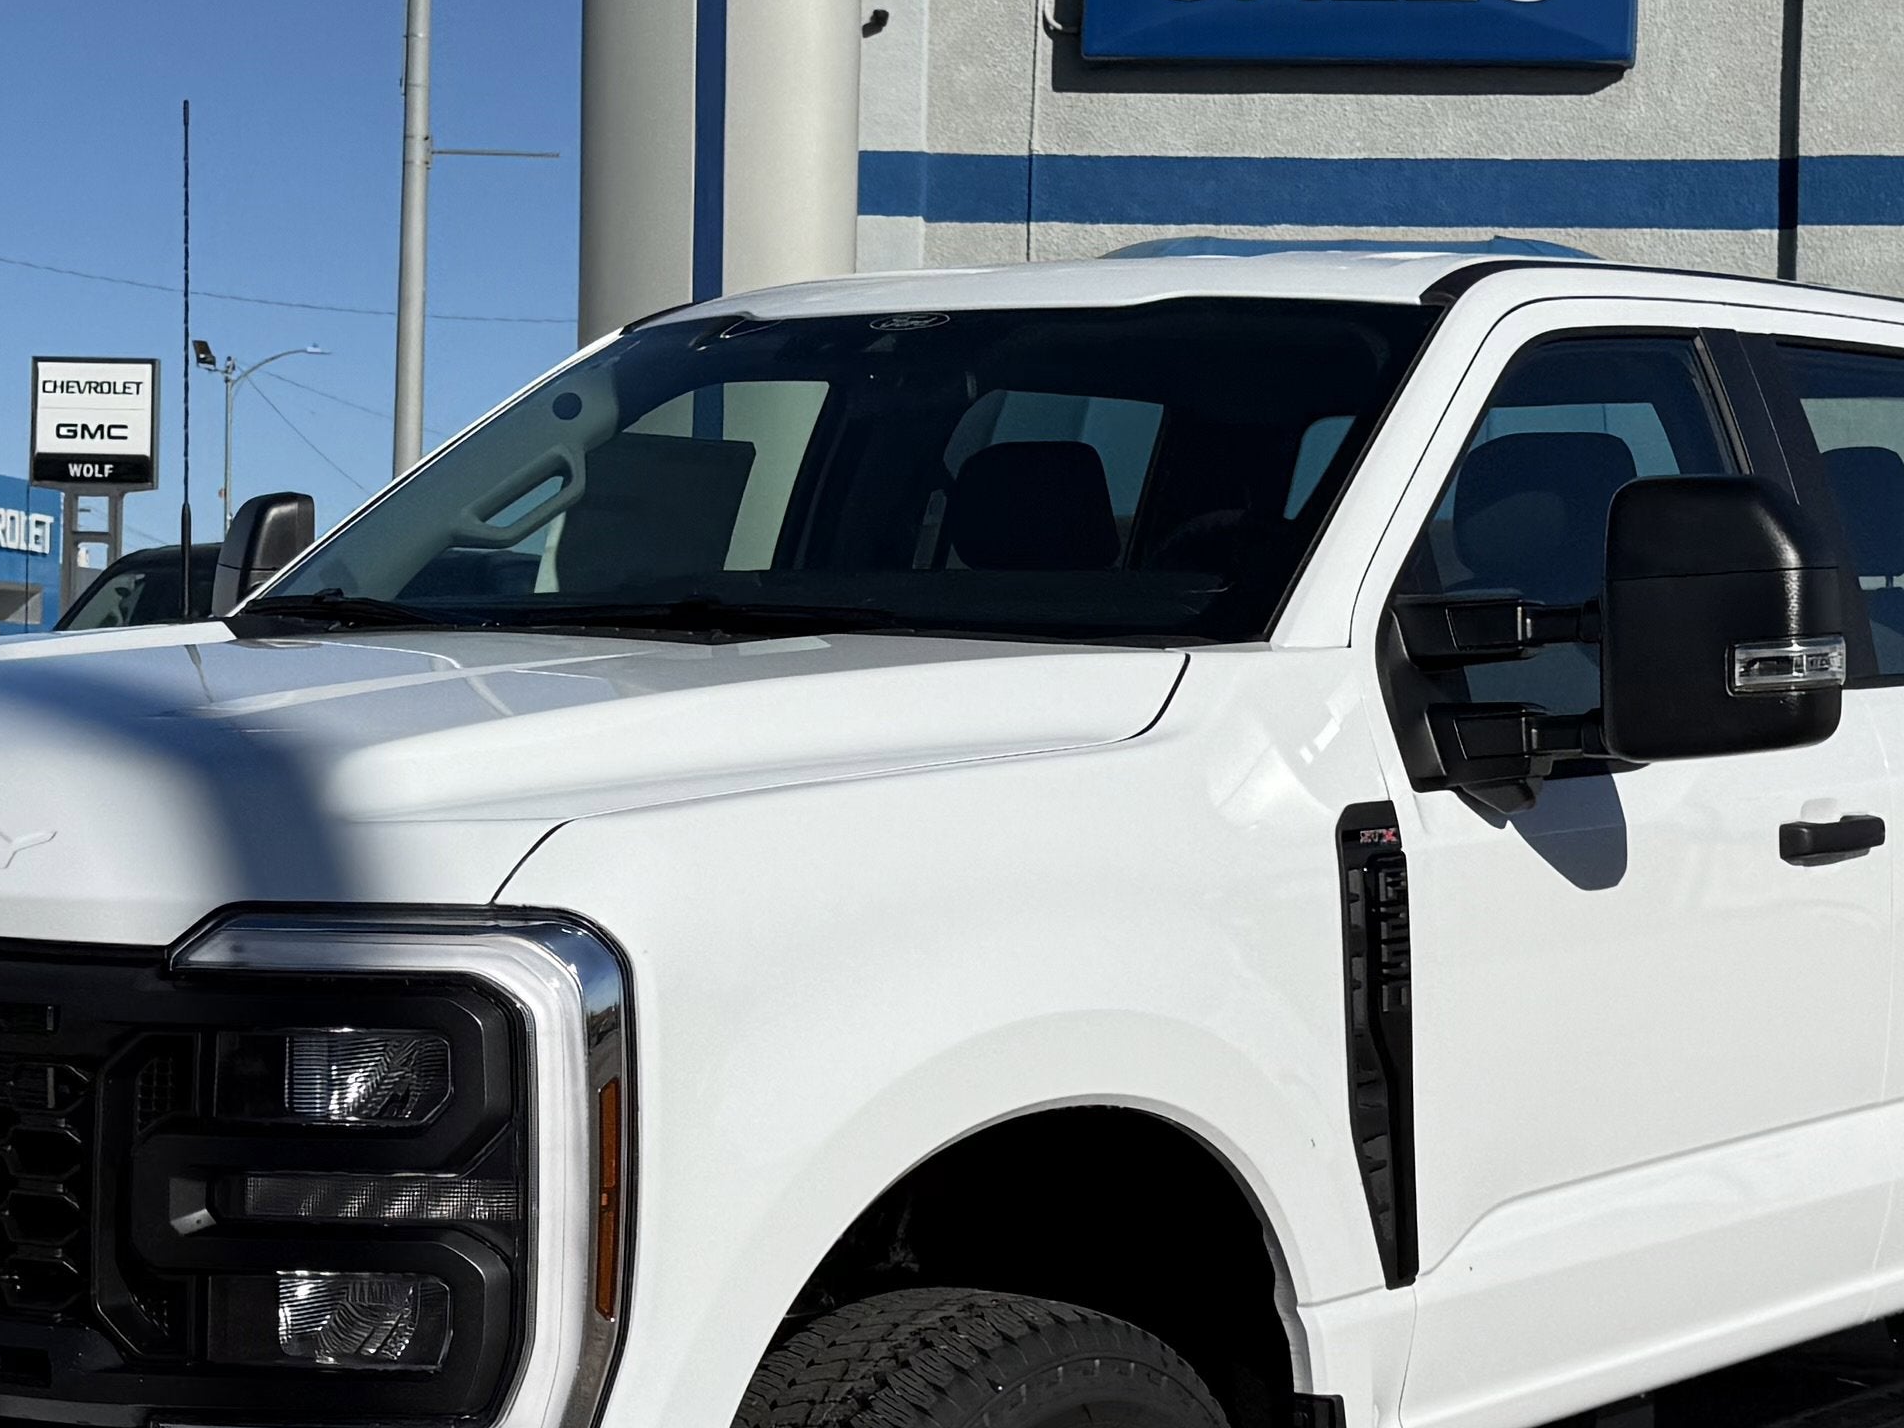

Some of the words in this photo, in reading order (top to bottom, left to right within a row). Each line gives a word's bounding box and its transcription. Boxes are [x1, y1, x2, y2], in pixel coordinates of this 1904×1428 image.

[42, 379, 144, 395] CHEVROLET
[55, 423, 128, 440] GMC
[68, 463, 114, 478] WOLF
